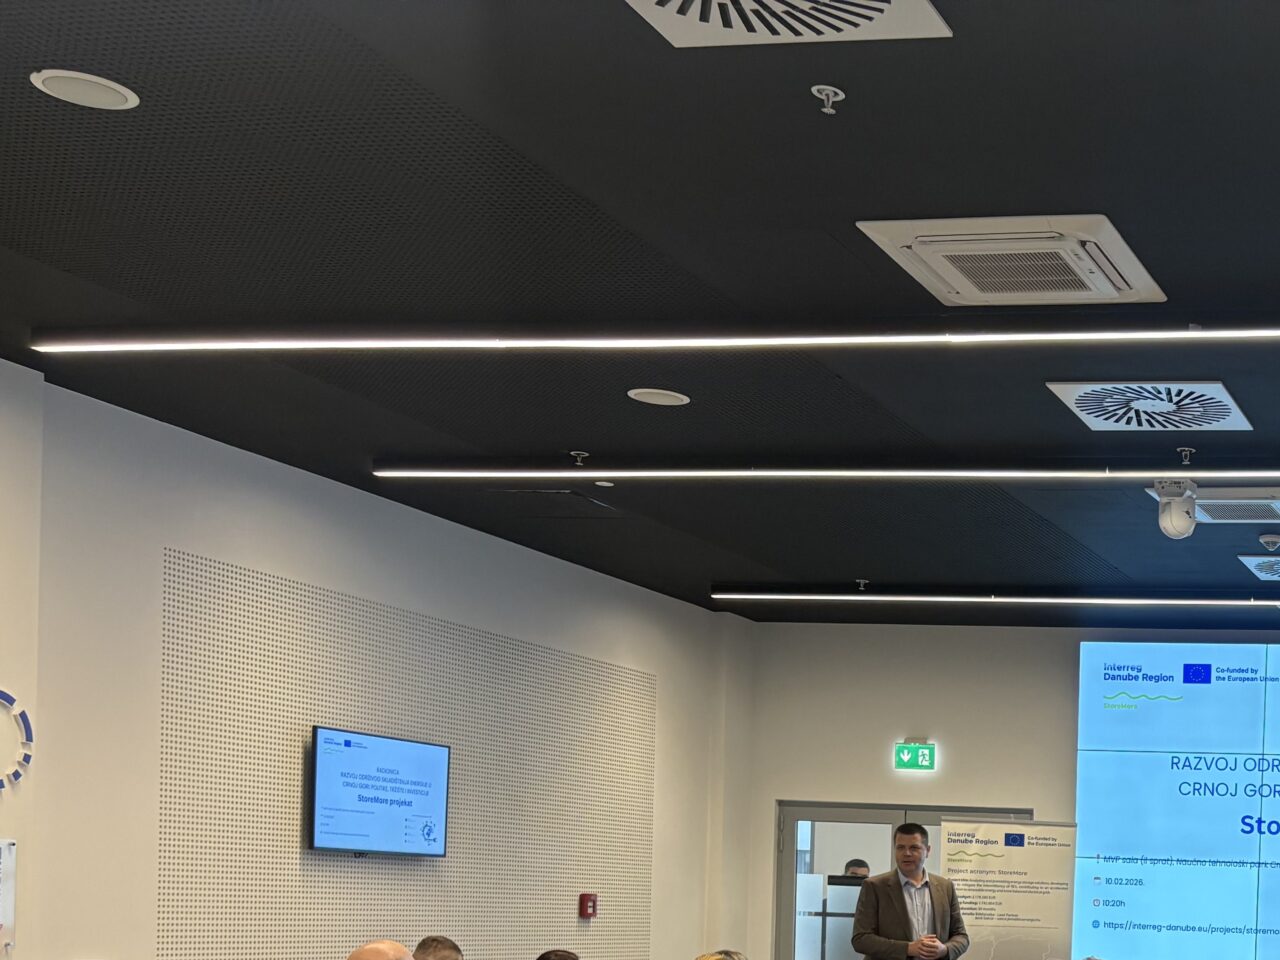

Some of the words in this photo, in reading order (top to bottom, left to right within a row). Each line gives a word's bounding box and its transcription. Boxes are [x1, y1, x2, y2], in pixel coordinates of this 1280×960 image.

[1103, 663, 1142, 673] Interreg
[1215, 666, 1249, 675] Co-funded
[1250, 667, 1259, 676] by
[1103, 672, 1140, 682] Danube
[1141, 673, 1175, 683] Region
[1227, 675, 1258, 683] European
[1259, 675, 1280, 683] Union
[1170, 756, 1238, 771] RAZVOJ
[1178, 781, 1238, 797] CRNOJ
[357, 794, 389, 804] StoreMore
[389, 798, 413, 808] projekat
[975, 838, 999, 846] Region
[998, 869, 1028, 877] StoreMore
[1105, 877, 1145, 886] 10.02.2026.
[1102, 899, 1126, 908] 10:20h
